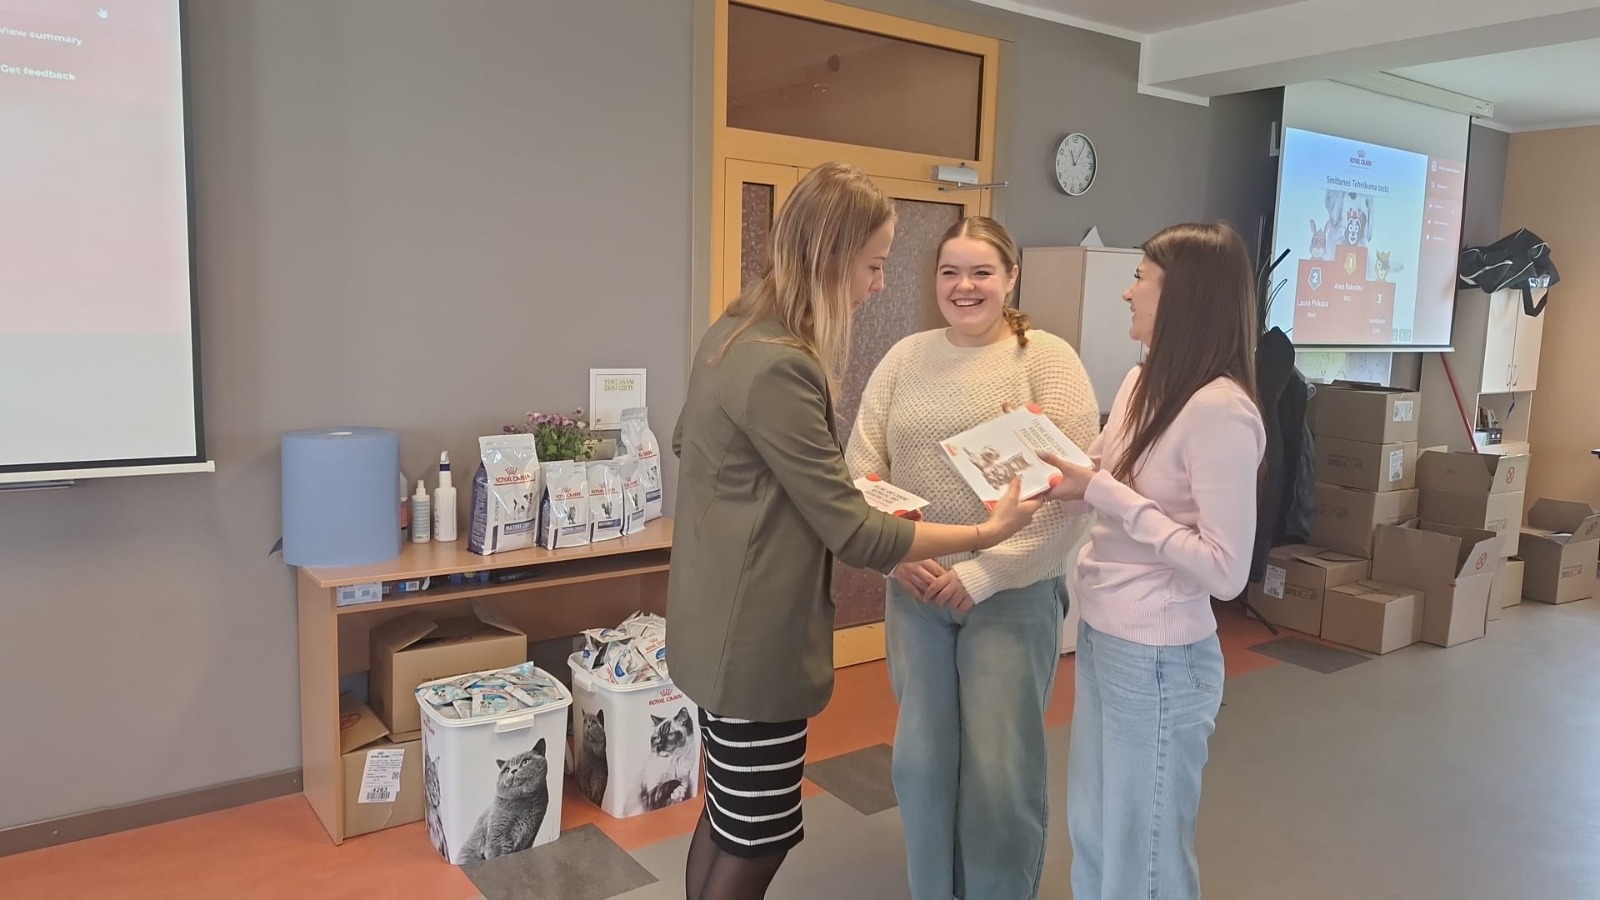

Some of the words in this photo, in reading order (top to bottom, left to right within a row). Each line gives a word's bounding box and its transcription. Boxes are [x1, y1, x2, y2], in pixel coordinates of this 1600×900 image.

[0, 27, 26, 37] View
[29, 31, 82, 46] summary
[0, 64, 20, 74] Get
[24, 66, 76, 80] feedback
[1326, 175, 1351, 186] Smiltenes
[1352, 180, 1377, 191] Tehnikuma
[1378, 184, 1390, 193] tests
[1312, 273, 1318, 283] 2
[1377, 294, 1382, 304] 3
[667, 694, 682, 702] CANIN
